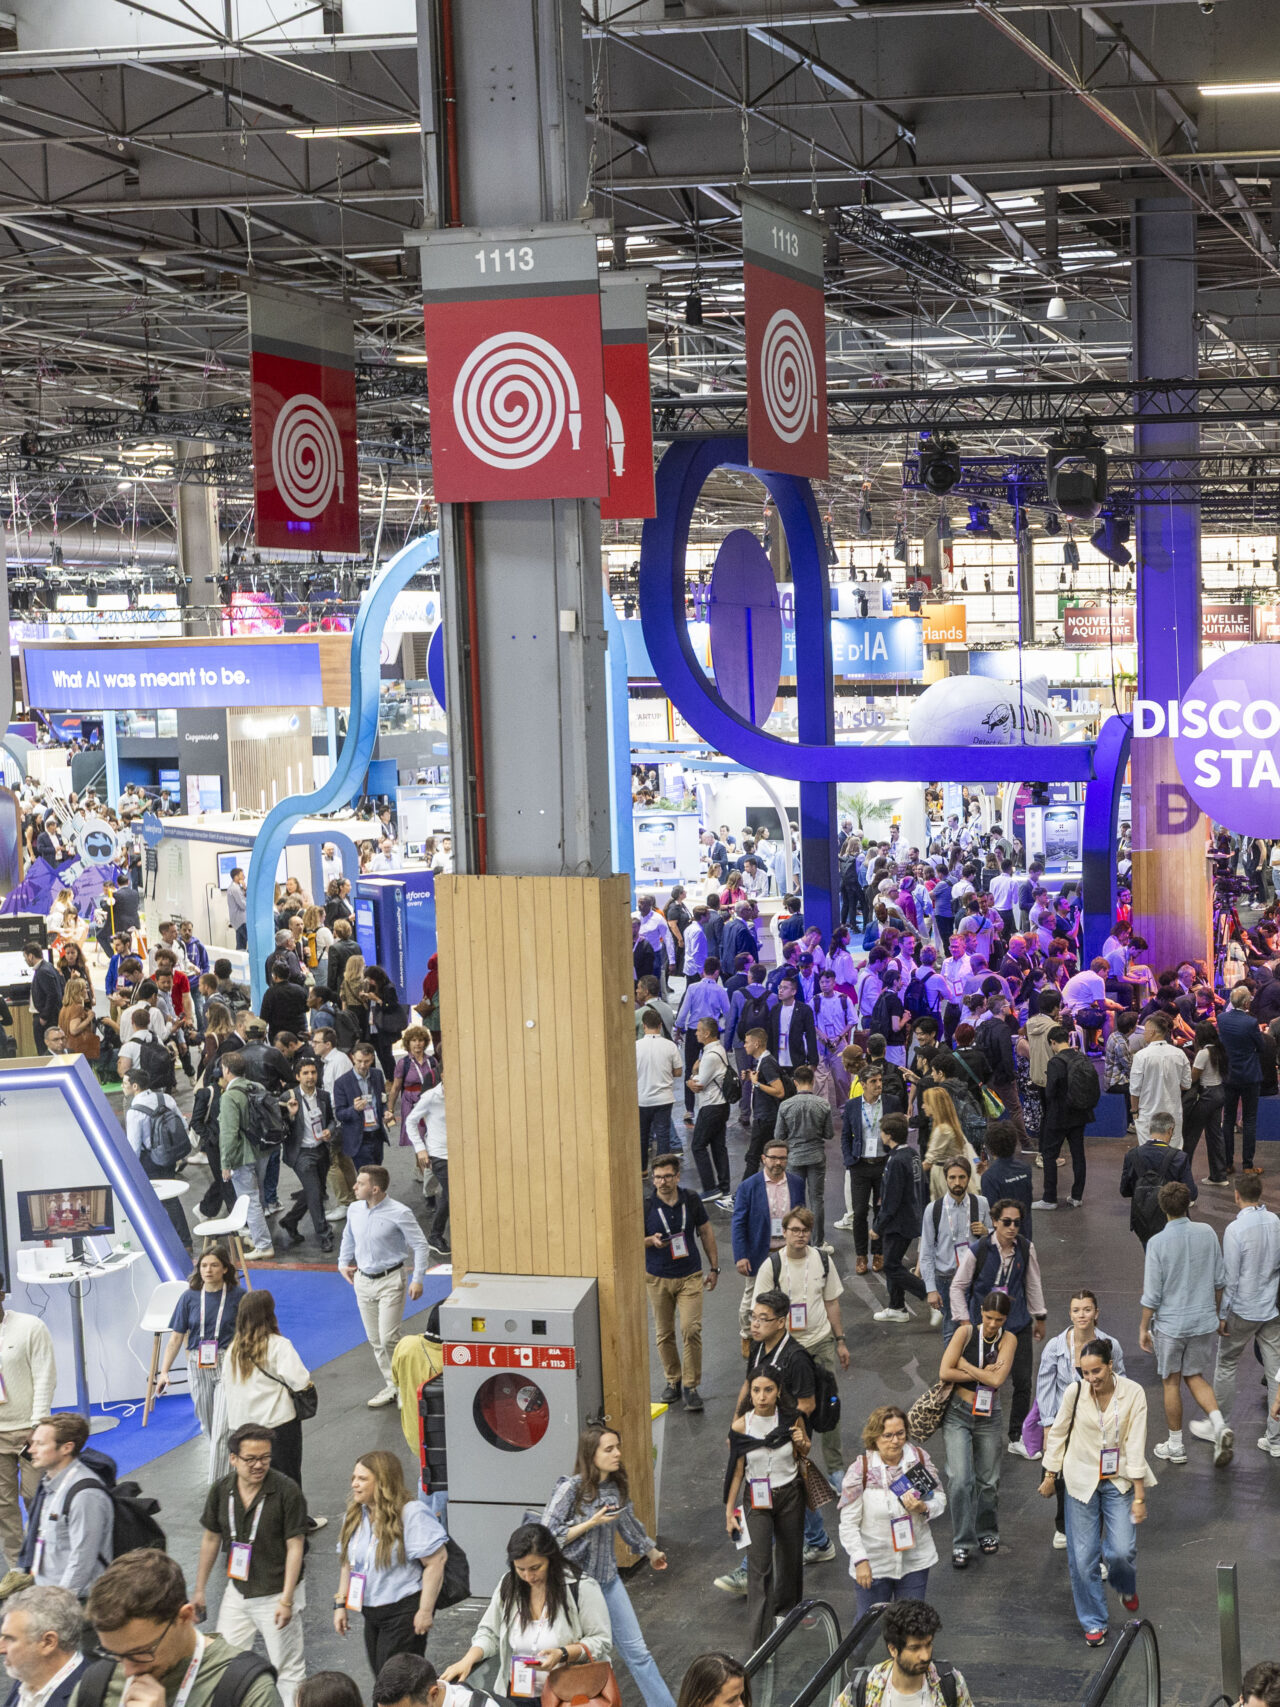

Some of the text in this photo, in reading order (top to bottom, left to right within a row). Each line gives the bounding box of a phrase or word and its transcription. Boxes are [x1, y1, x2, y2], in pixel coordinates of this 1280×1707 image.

[771, 226, 799, 257] 1113
[474, 247, 535, 274] 1113
[1067, 616, 1130, 627] NOUVELLE-
[1072, 626, 1131, 636] AQUITAINE
[53, 667, 250, 689] What AI was meant to be.
[185, 732, 214, 743] Capgemini
[550, 1360, 566, 1368] 1113
